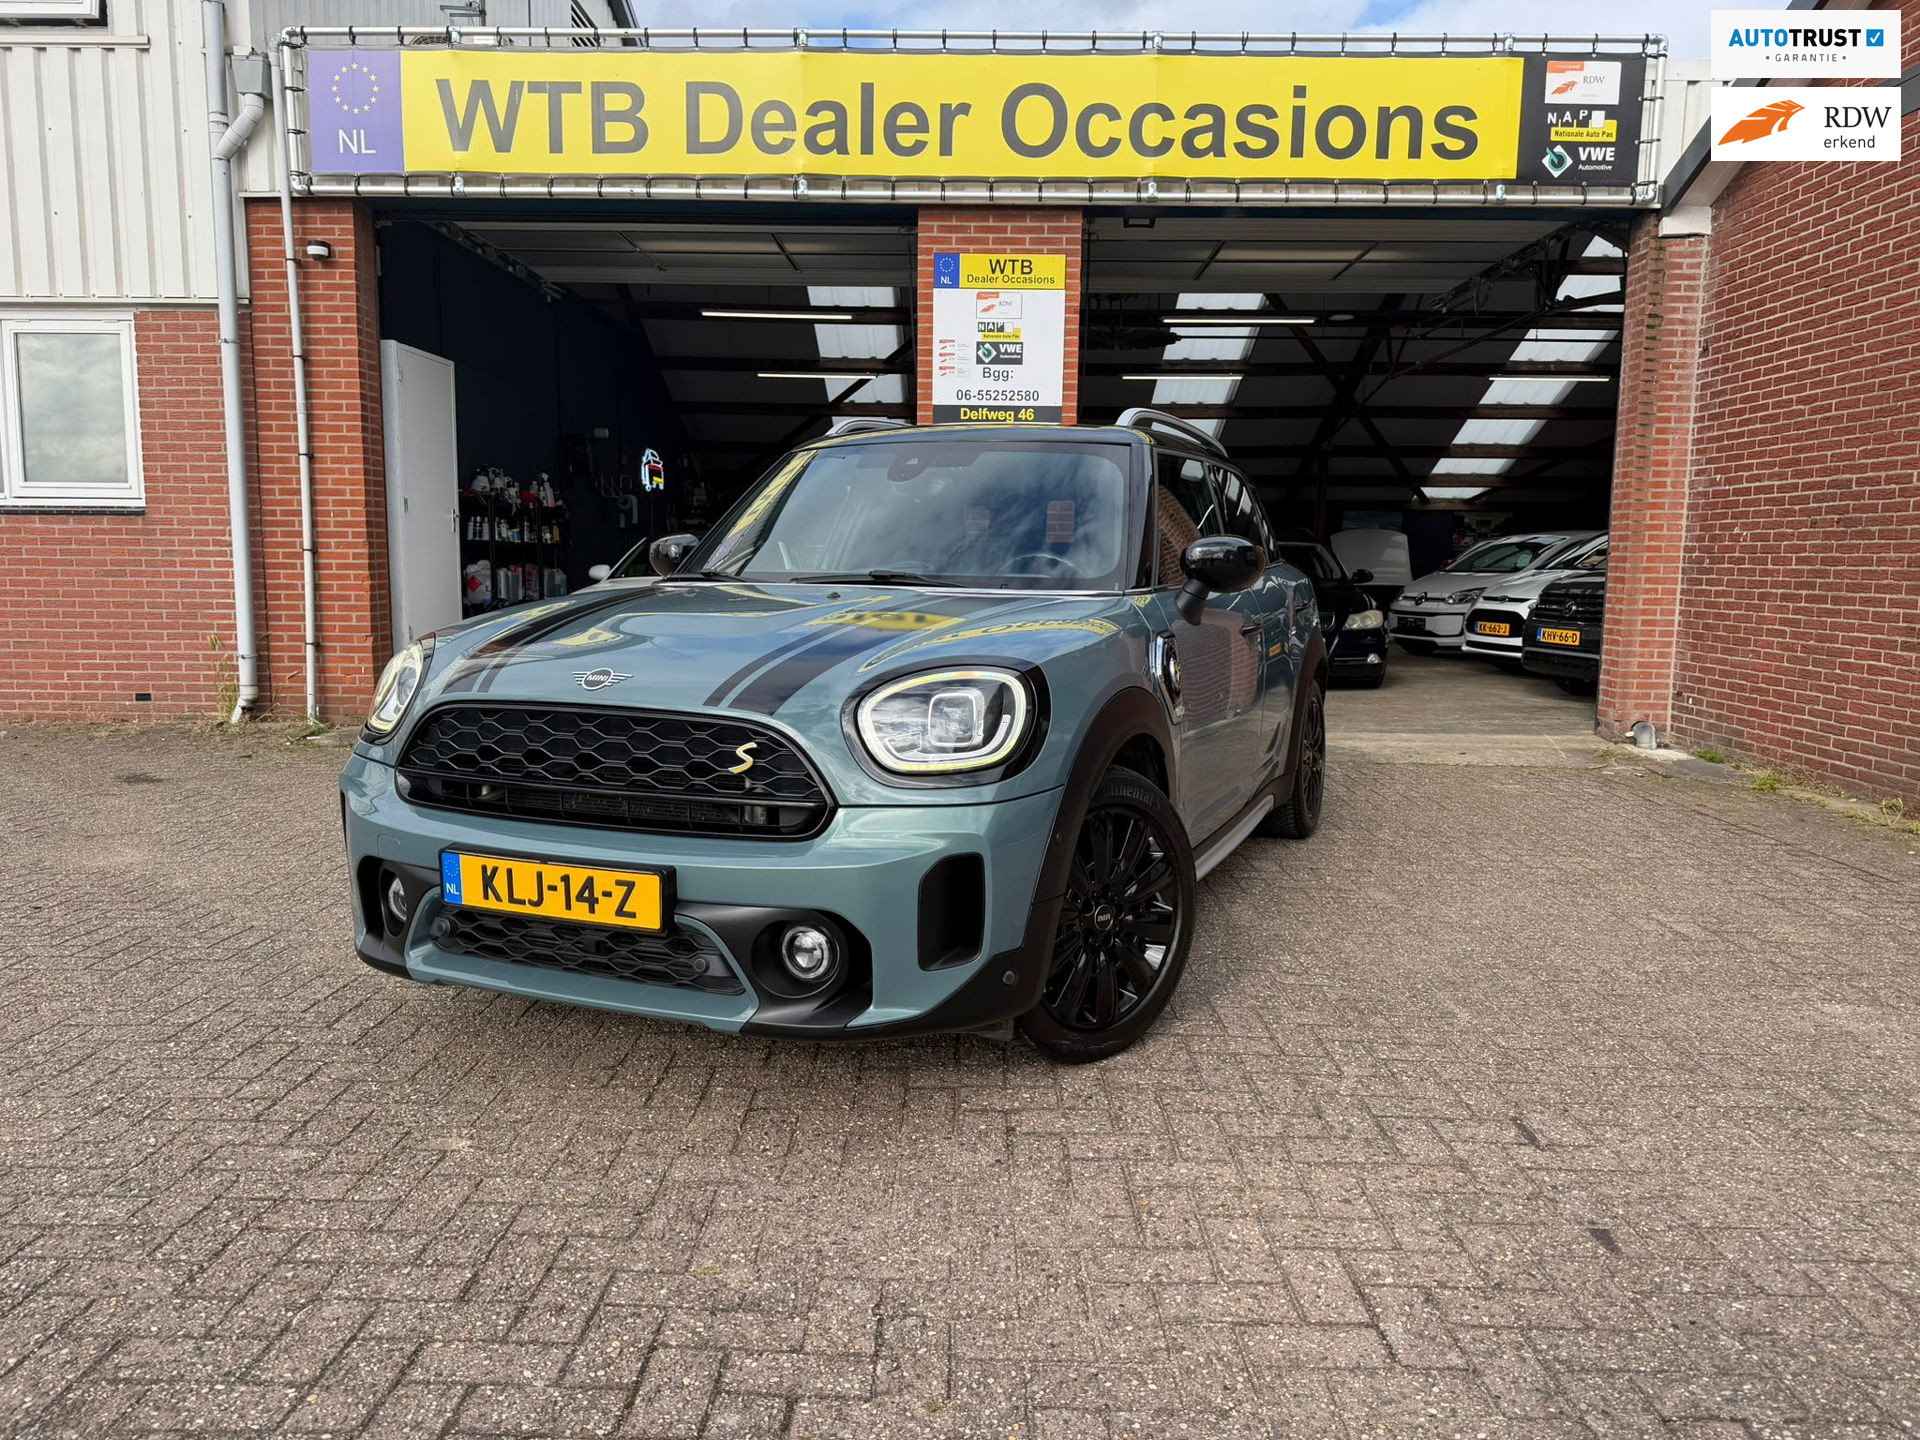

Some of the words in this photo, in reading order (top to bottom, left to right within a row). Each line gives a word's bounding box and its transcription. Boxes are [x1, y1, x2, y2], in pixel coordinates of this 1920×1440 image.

[1582, 75, 1606, 85] RDW
[435, 79, 650, 155] WTB
[685, 80, 973, 157] Dealer
[1001, 82, 1479, 161] Occasions
[1554, 130, 1585, 138] Nationale
[1586, 130, 1600, 138] Auto
[1601, 130, 1614, 138] Pas
[338, 129, 377, 154] NL
[1578, 147, 1616, 161] VWE
[989, 258, 1034, 275] WTB
[940, 276, 952, 285] NL
[967, 274, 999, 284] Dealer
[1002, 274, 1056, 284] Occasions
[999, 343, 1022, 353] VWE
[982, 367, 1014, 381] Bgg:
[956, 389, 1040, 401] 06-55252580
[961, 407, 1014, 423] Delfweg
[1018, 408, 1034, 420] 46
[1541, 629, 1578, 643] KHV-66-D
[586, 674, 609, 682] MINI
[727, 741, 758, 775] S
[446, 883, 459, 895] NL
[480, 863, 637, 919] KLJ-14-Z
